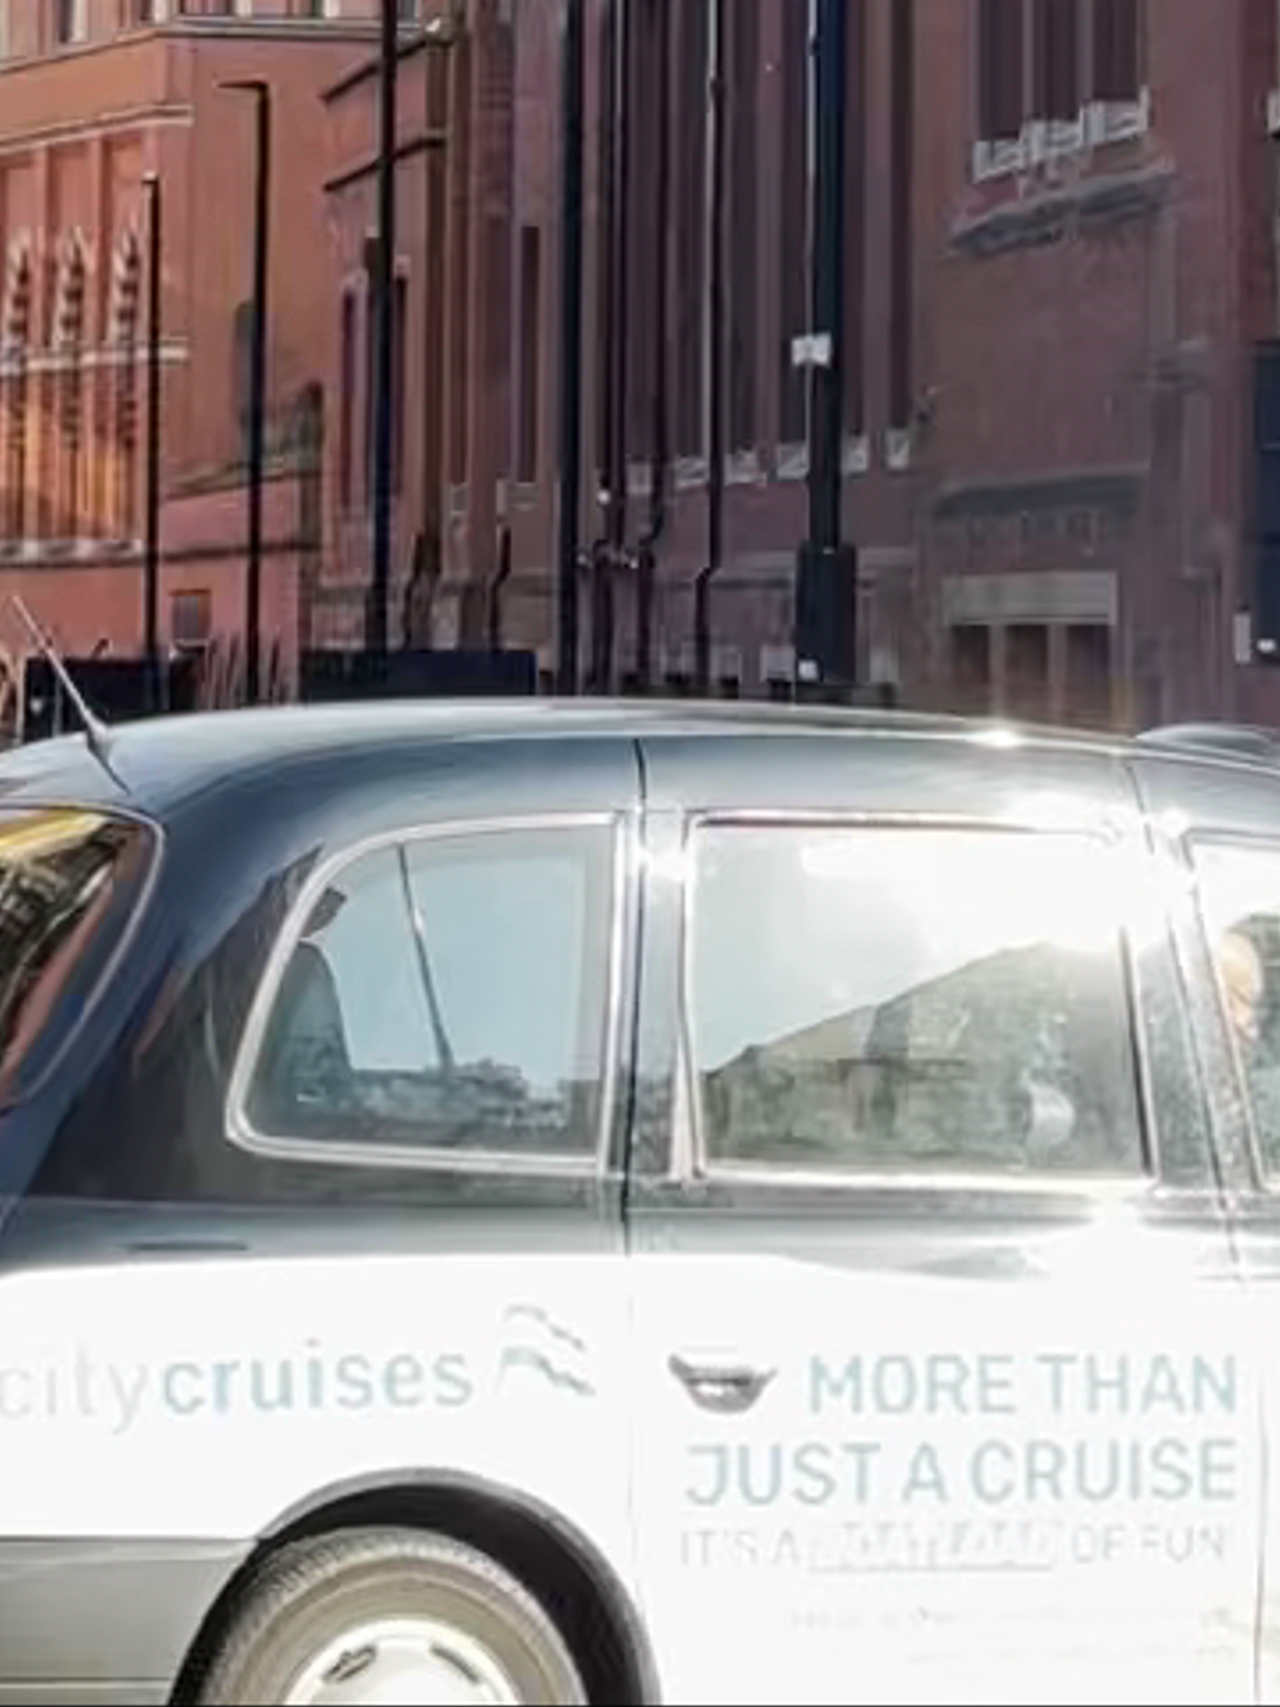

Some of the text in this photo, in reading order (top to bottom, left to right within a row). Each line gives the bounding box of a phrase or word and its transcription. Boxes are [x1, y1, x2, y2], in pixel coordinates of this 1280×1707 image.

[807, 1352, 1238, 1416] MORE THAN
[682, 1437, 1238, 1507] JUST A CRUISE
[1070, 1525, 1126, 1565] OF
